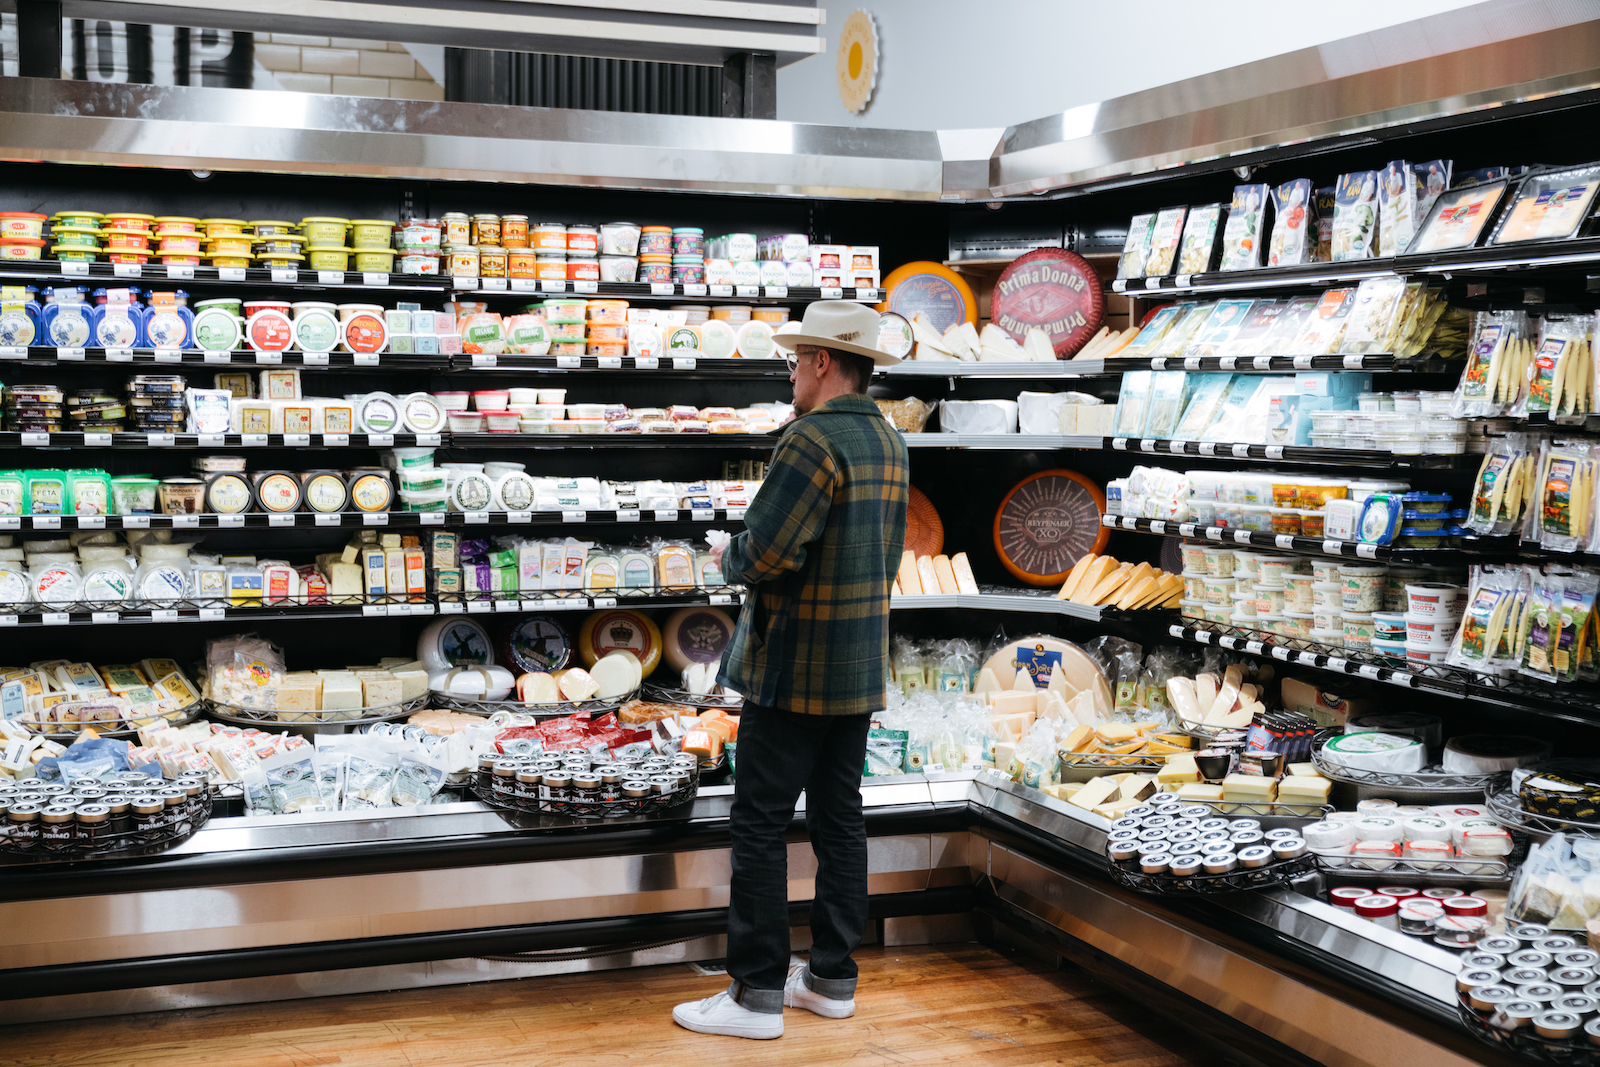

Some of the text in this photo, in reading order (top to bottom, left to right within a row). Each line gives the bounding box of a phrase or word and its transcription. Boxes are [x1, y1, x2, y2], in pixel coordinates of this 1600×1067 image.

[1319, 198, 1336, 209] RAN
[998, 266, 1085, 297] Prima Donna
[1044, 310, 1087, 336] Prima
[474, 327, 495, 336] ORGANIC
[520, 328, 539, 338] ORGANIC
[364, 496, 383, 506] FETA
[1010, 658, 1031, 670] GRAN
[1252, 732, 1265, 744] Fondue
[492, 783, 513, 793] PRIMO
[187, 803, 203, 812] RIMO
[138, 821, 164, 830] PRIMO
